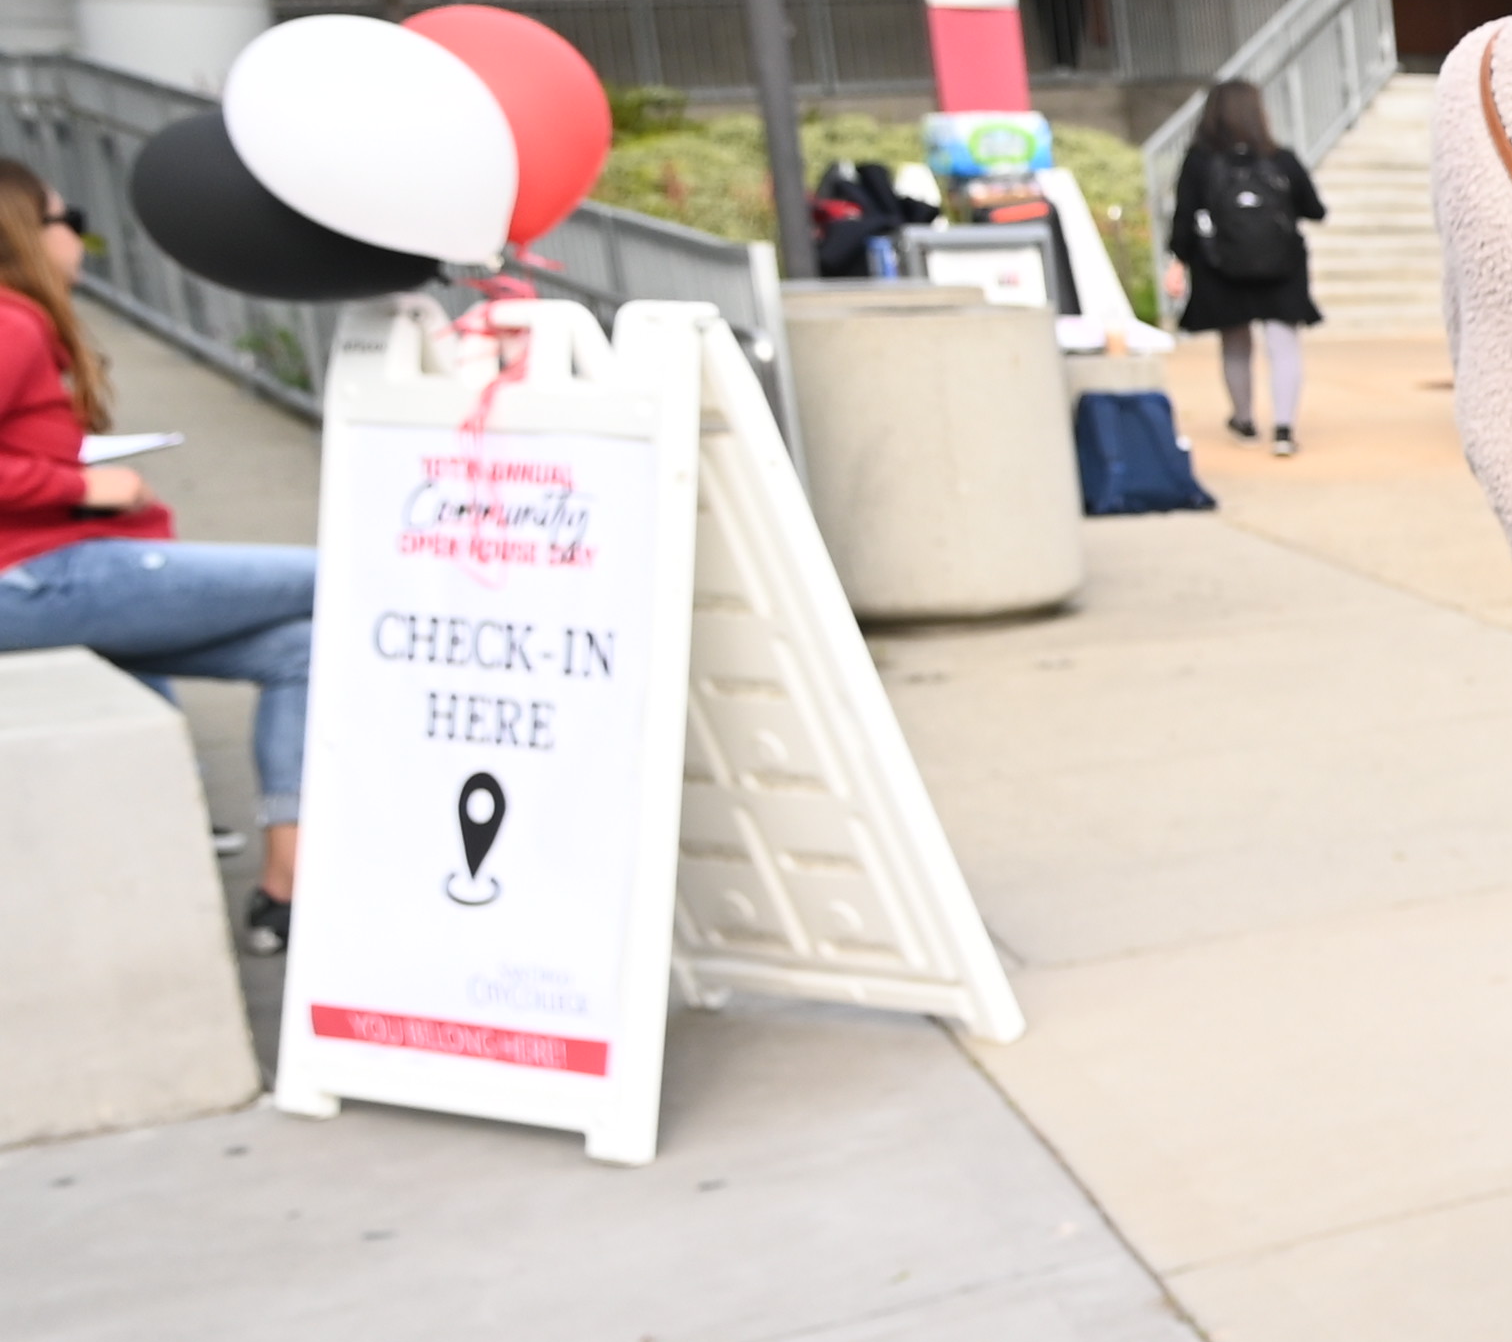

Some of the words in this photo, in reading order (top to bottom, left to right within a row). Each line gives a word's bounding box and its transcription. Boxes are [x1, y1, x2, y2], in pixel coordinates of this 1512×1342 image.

[402, 479, 596, 561] Community
[373, 611, 616, 679] CHECK-IN
[426, 691, 556, 750] HERE
